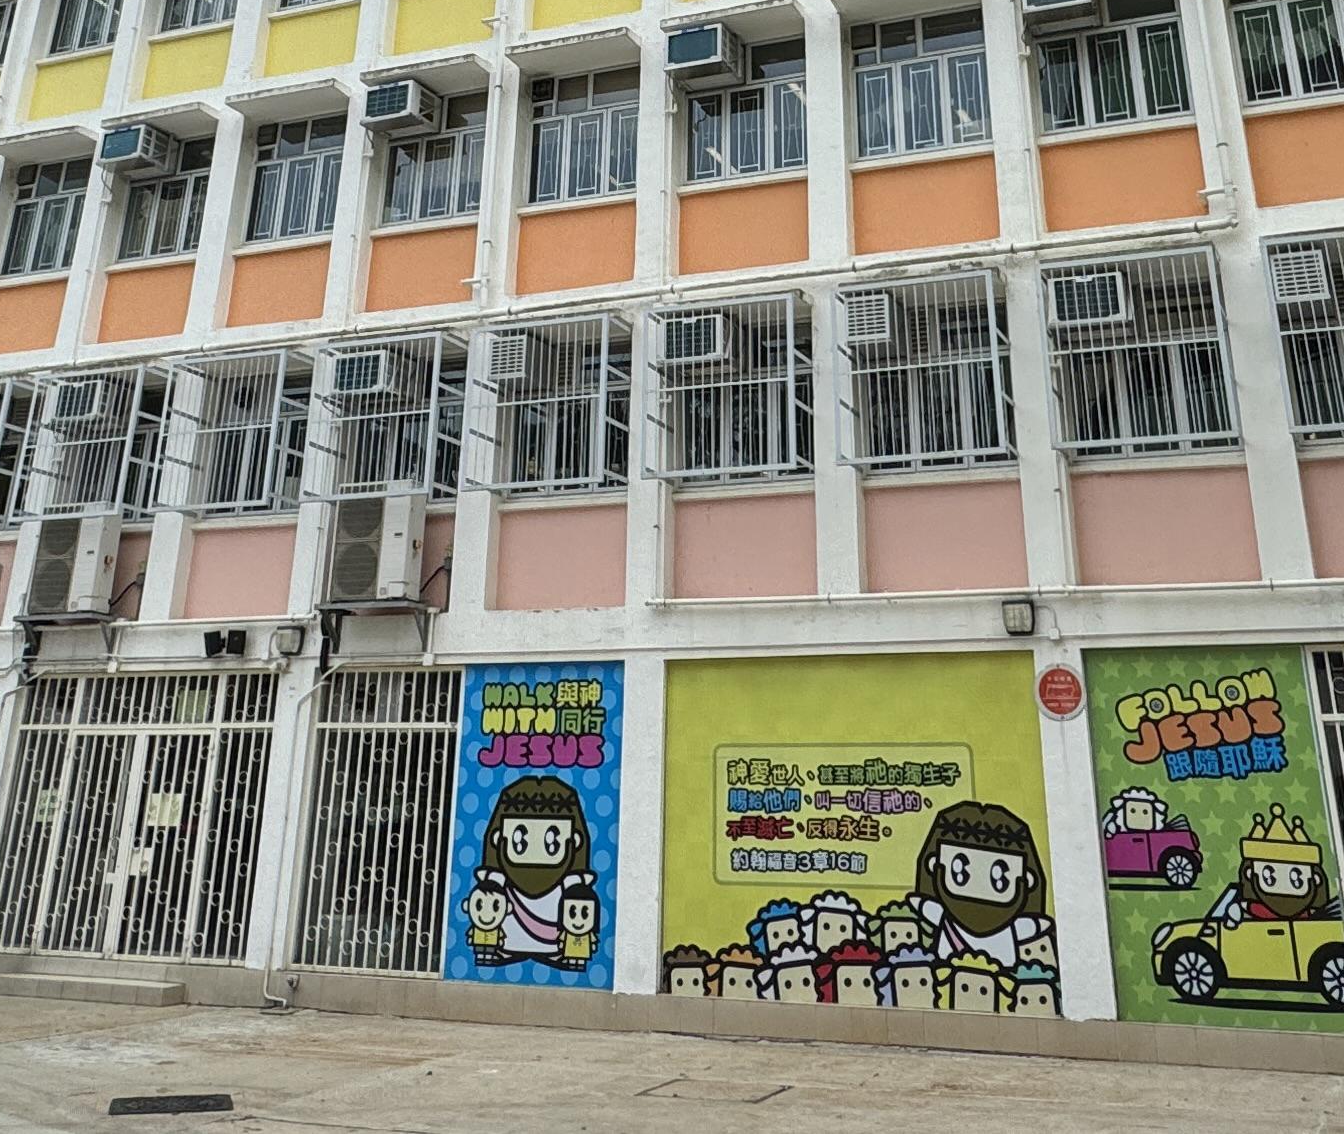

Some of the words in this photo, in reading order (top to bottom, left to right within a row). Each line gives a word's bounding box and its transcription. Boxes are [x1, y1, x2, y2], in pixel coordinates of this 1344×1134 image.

[483, 682, 555, 707] WALK
[556, 678, 602, 707] 與神
[1115, 668, 1277, 732] FOLLOW
[482, 707, 556, 734] WITH
[559, 708, 605, 735] 同行
[1123, 699, 1286, 764] JESUS
[478, 734, 605, 768] JESUS
[1163, 733, 1289, 782] 跟隨耶穌
[731, 847, 868, 875] 約翰福音3章16節
